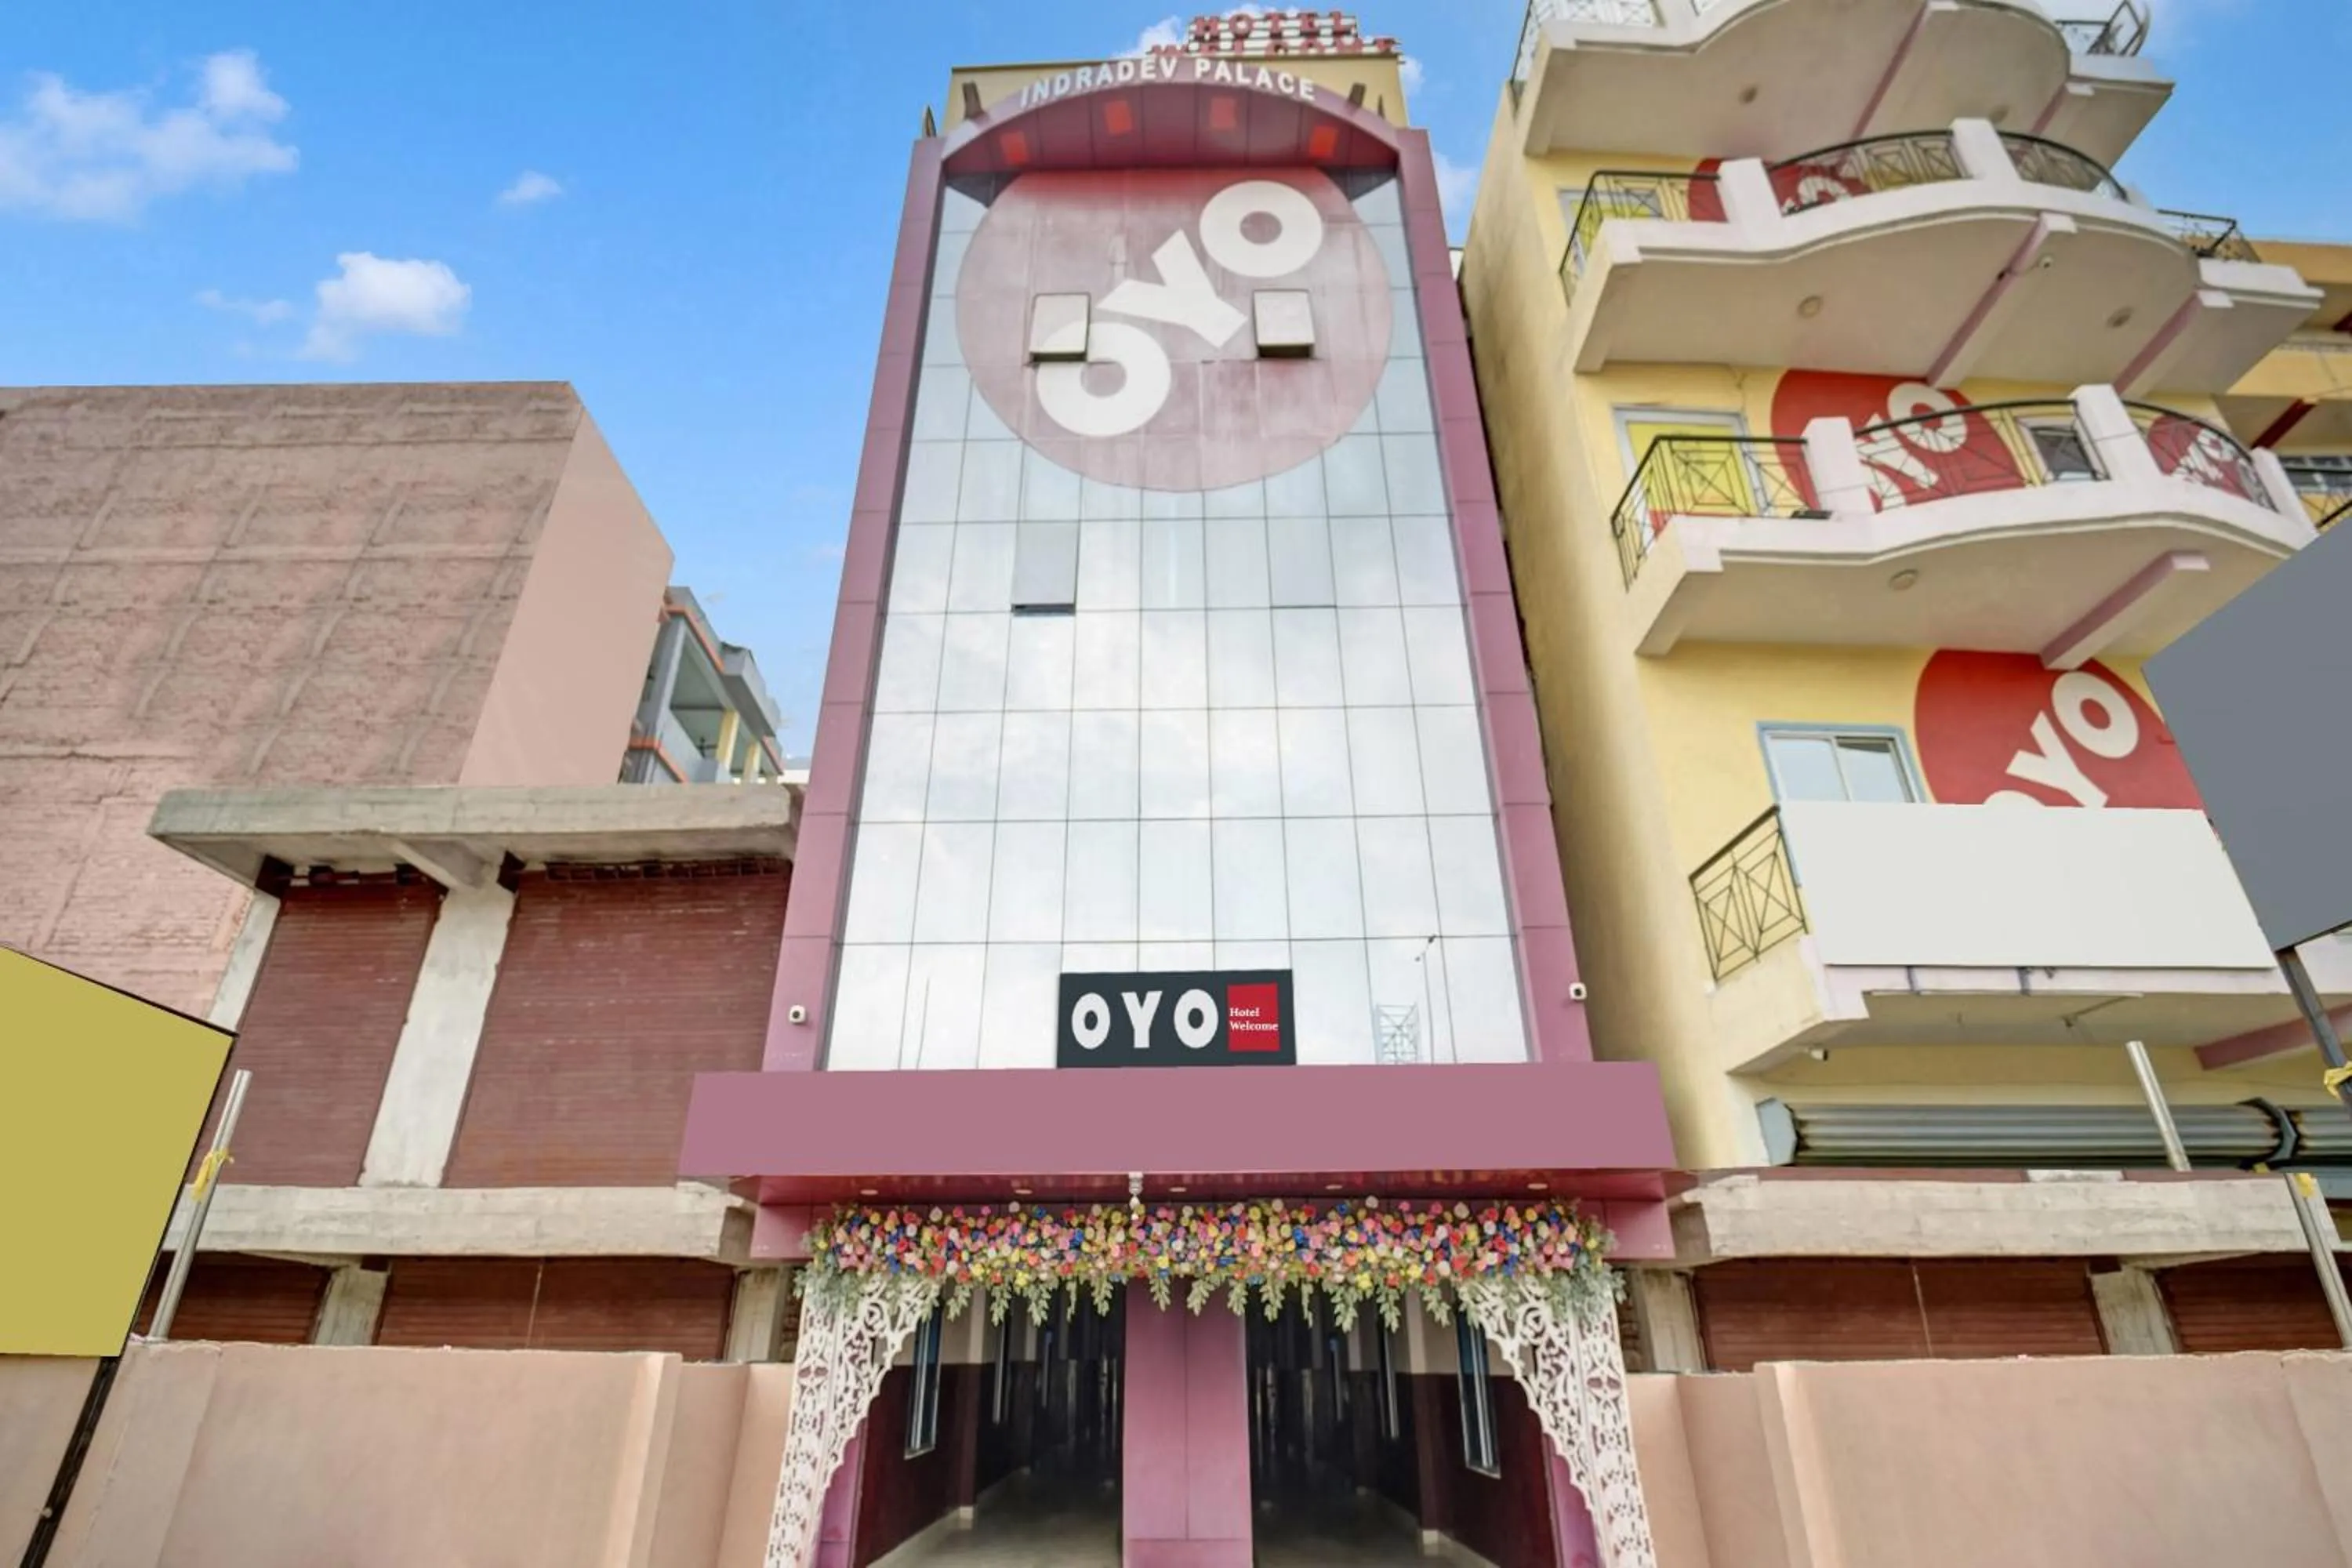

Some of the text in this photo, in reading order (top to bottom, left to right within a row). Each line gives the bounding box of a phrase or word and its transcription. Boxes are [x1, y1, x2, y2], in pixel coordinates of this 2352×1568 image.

[1192, 11, 1356, 38] HOTEL
[1020, 57, 1316, 108] INDRADEV PALACE
[1036, 180, 1323, 437] OYO
[1982, 670, 2139, 808] YO
[1072, 989, 1218, 1049] OYO
[1229, 1007, 1260, 1017] Hotel
[1229, 1020, 1279, 1031] Welcome
